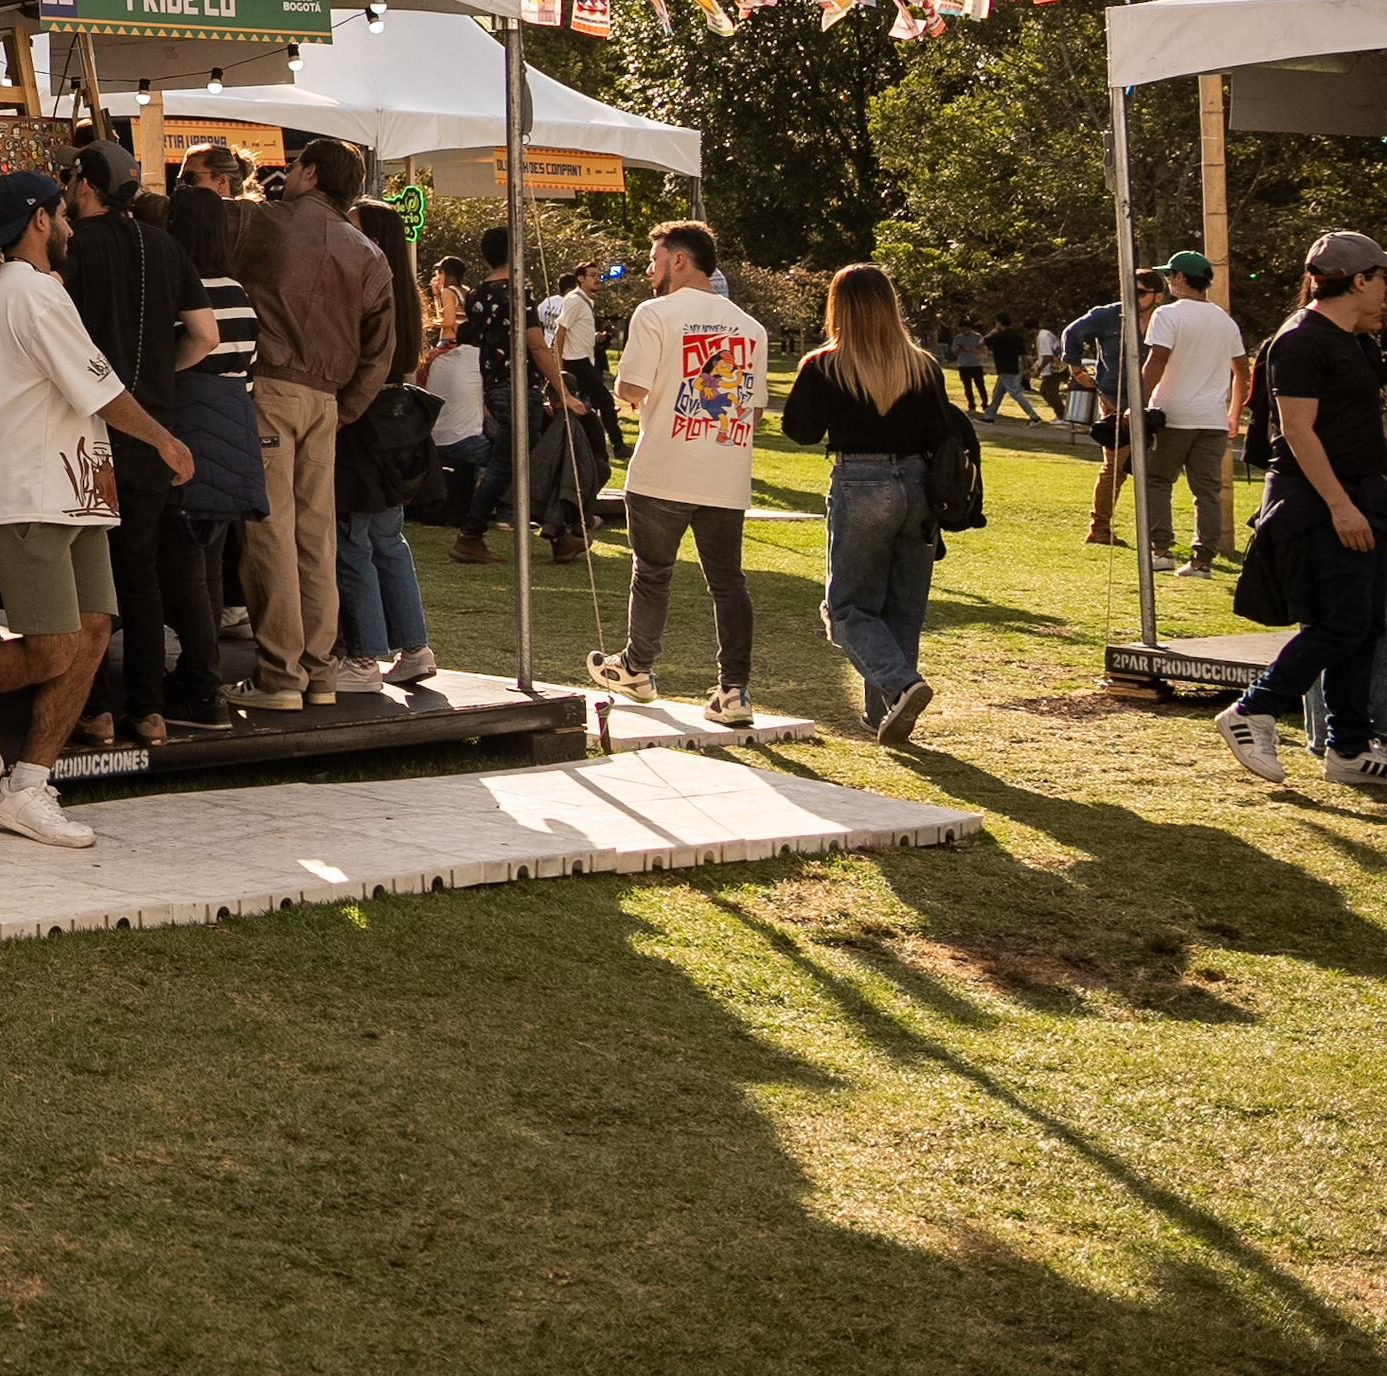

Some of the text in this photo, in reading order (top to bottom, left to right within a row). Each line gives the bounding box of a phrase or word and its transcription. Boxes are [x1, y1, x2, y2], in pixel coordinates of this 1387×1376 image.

[283, 0, 322, 14] BOGOTÁ
[545, 163, 582, 177] COMPANY
[1112, 653, 1149, 672] 2PAR
[49, 749, 149, 780] RODUCCIONES
